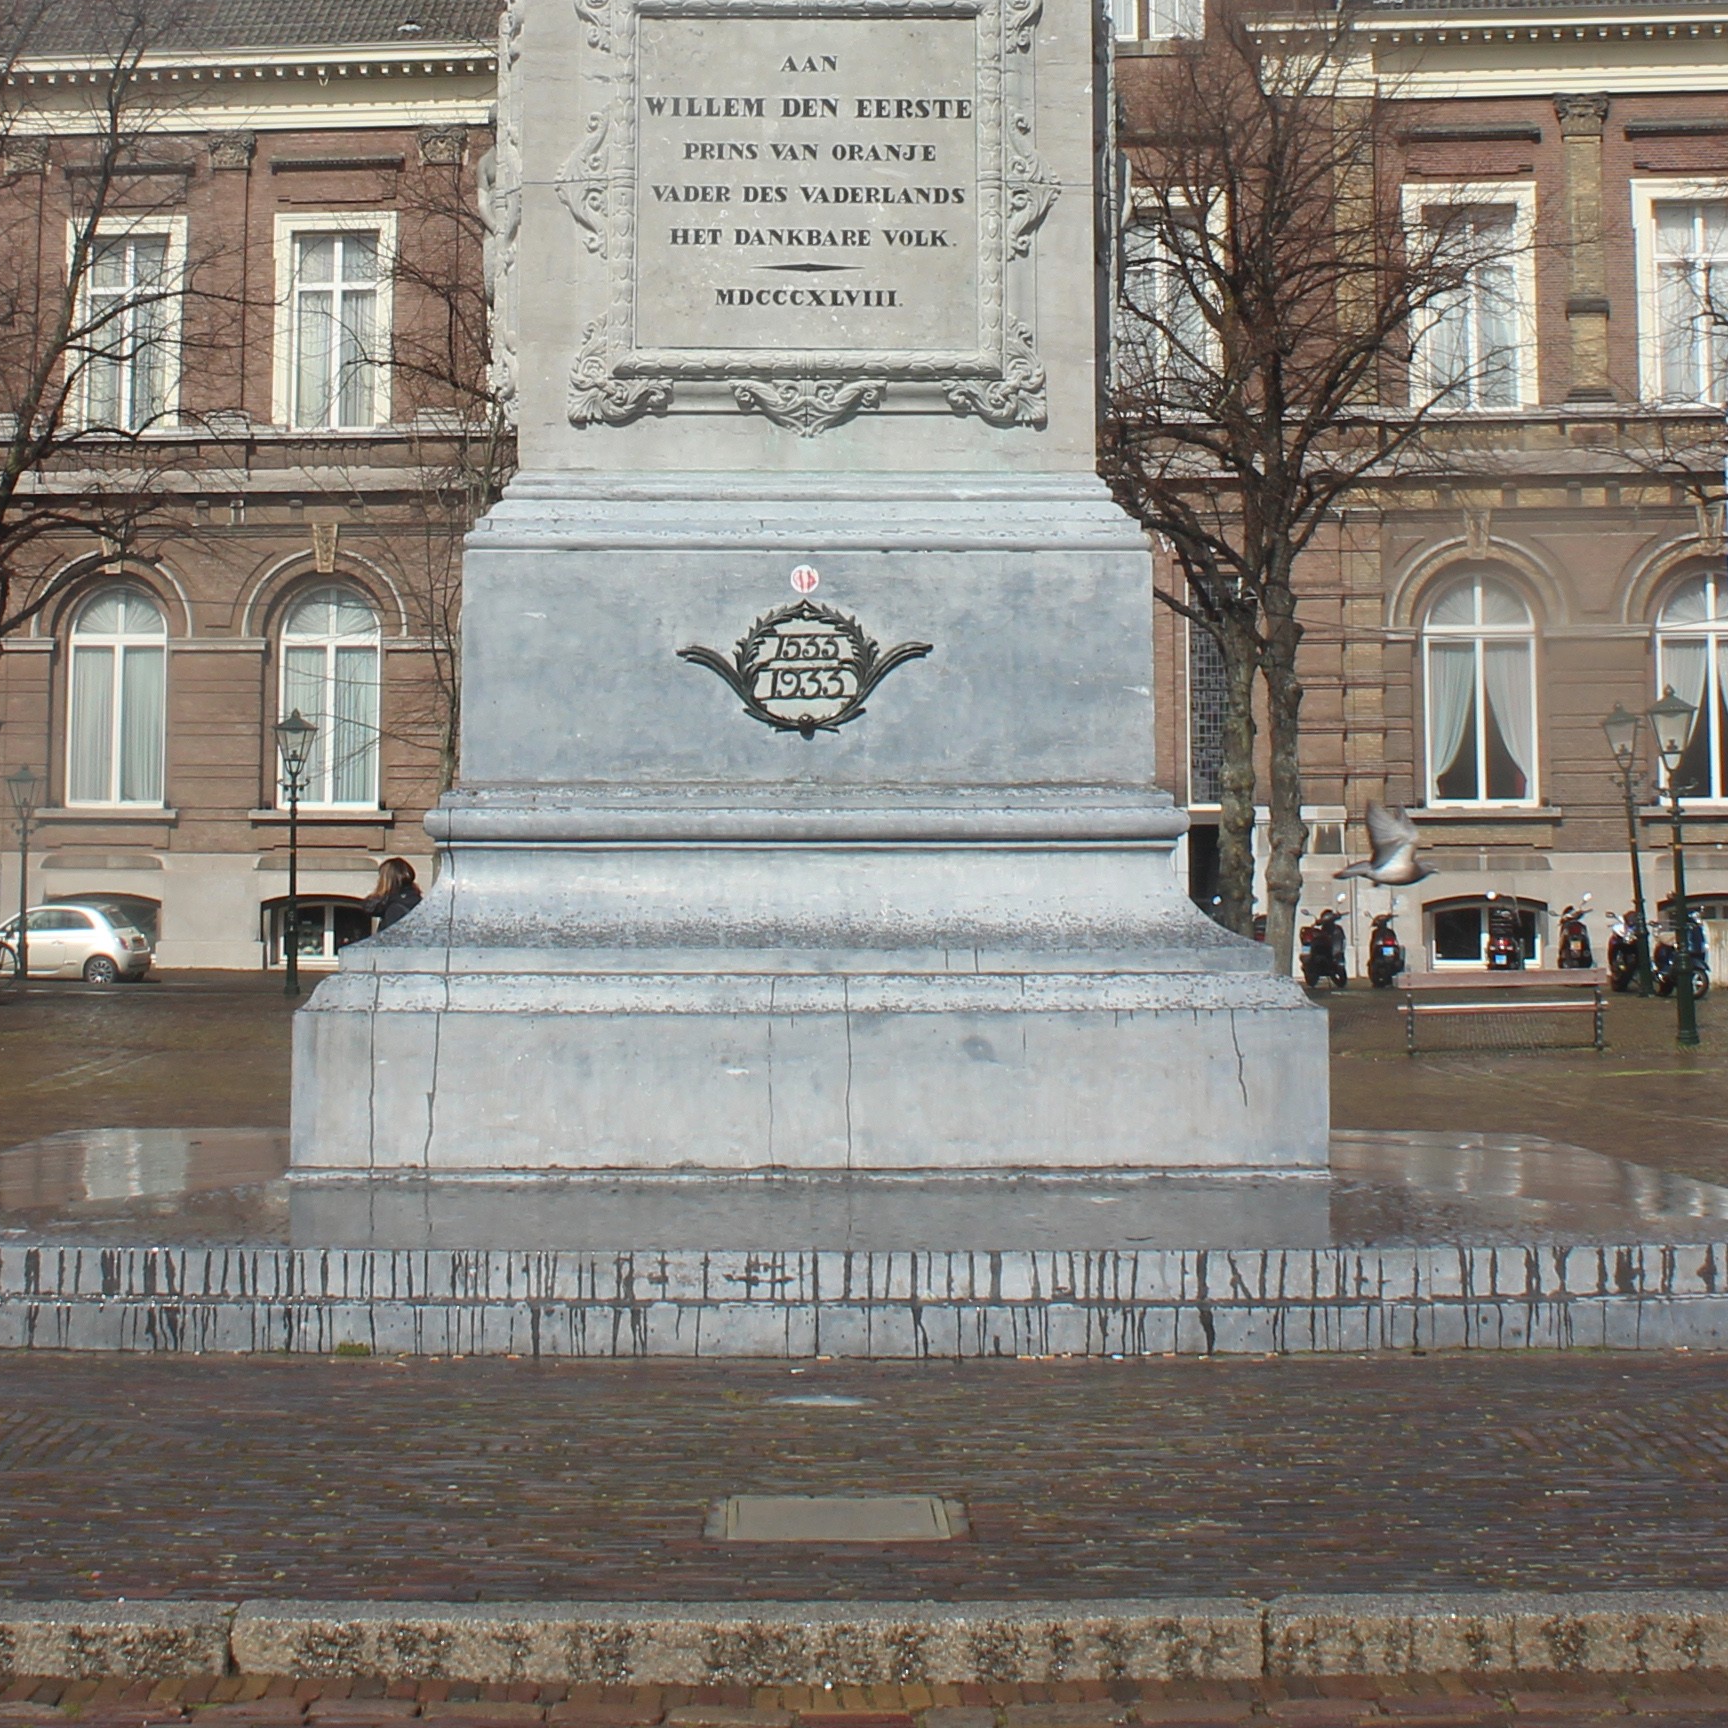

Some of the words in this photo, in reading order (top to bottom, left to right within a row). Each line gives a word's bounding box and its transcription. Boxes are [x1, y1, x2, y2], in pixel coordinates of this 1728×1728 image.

[780, 56, 838, 73] AAN
[645, 96, 765, 118] WILLEM
[780, 97, 839, 118] DEN
[855, 98, 972, 120] EERSTE
[683, 142, 758, 161] PRINS
[771, 143, 818, 161] VAN
[832, 143, 937, 162] ORANJE
[651, 185, 731, 203] VADER
[742, 185, 787, 204] DES
[800, 186, 966, 205] VADERLANDS
[670, 227, 722, 246] HET
[733, 228, 871, 247] DANKBARE
[882, 229, 958, 248] VOLK.
[715, 288, 904, 308] MDCCCXLVIII.
[776, 635, 840, 660] 1533
[772, 669, 845, 699] 1933
